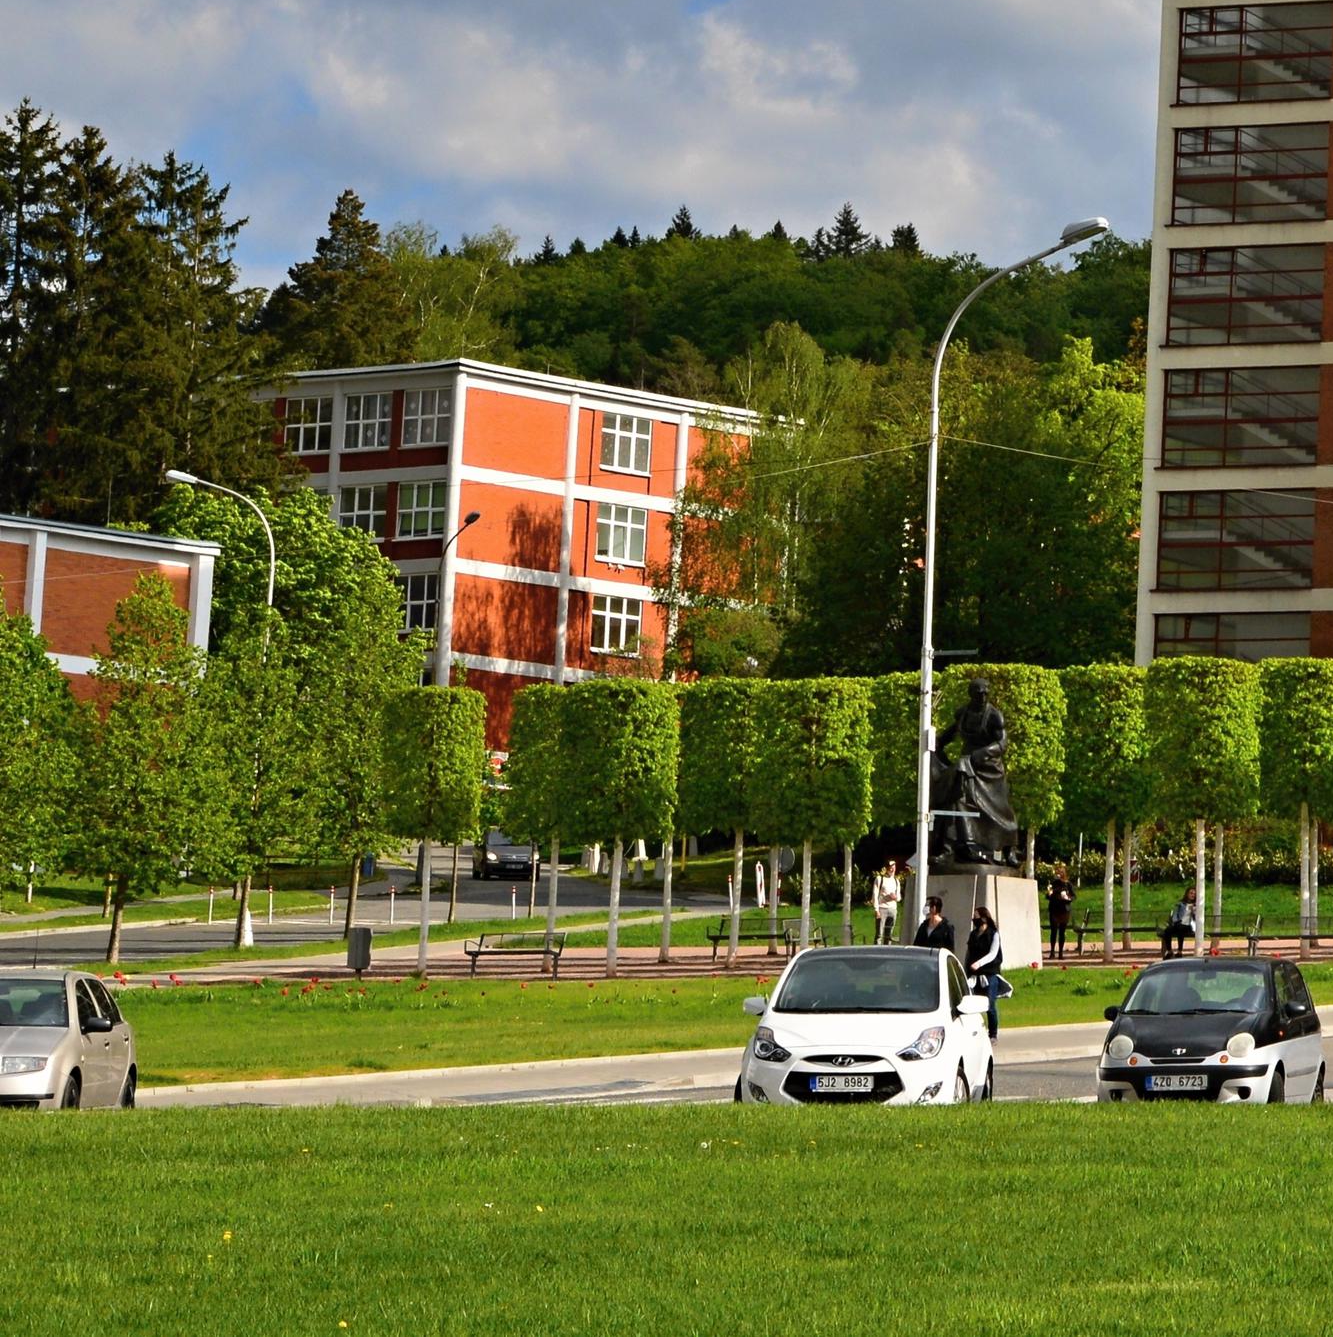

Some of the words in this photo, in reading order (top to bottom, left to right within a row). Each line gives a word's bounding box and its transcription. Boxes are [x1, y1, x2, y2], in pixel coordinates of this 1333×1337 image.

[818, 1077, 836, 1088] 5J2
[844, 1077, 869, 1088] 8982
[1178, 1076, 1204, 1087] 6723
